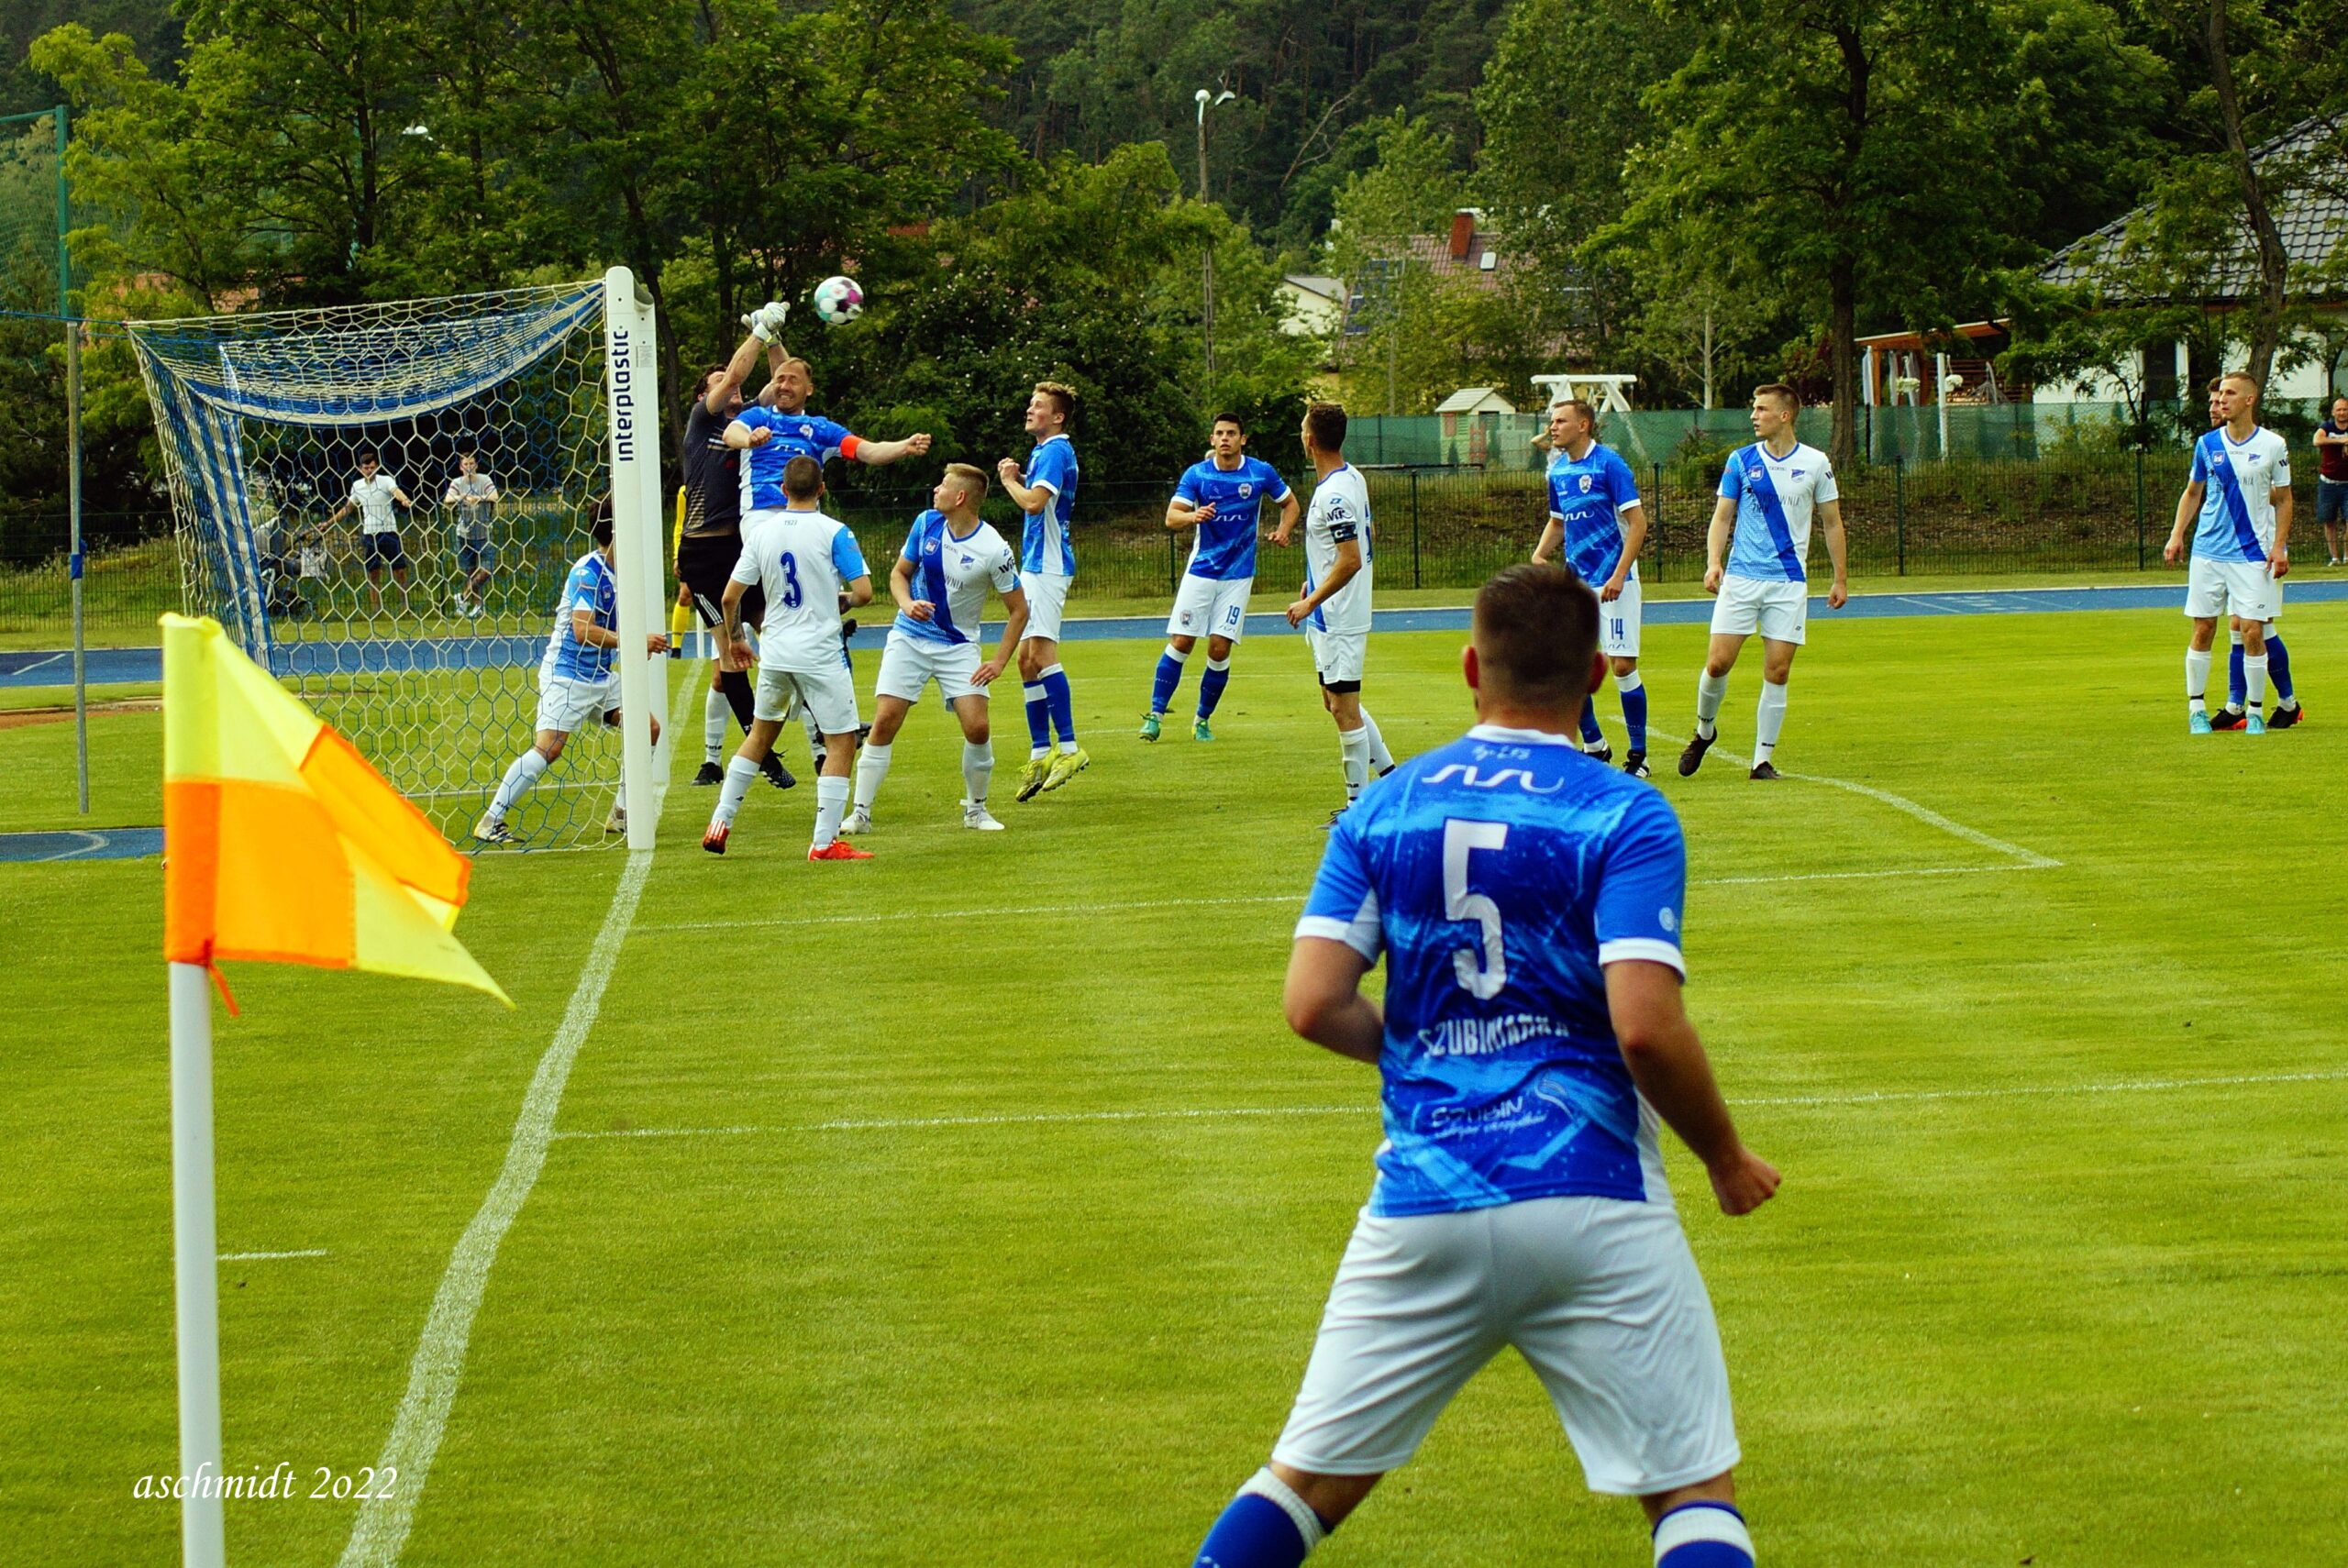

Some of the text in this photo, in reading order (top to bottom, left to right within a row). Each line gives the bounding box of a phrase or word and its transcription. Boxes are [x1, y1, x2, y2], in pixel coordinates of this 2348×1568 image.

[611, 330, 634, 461] interplastic
[779, 550, 803, 610] 3
[1225, 604, 1240, 625] 19
[1610, 618, 1624, 640] 14
[1443, 818, 1508, 1000] 5
